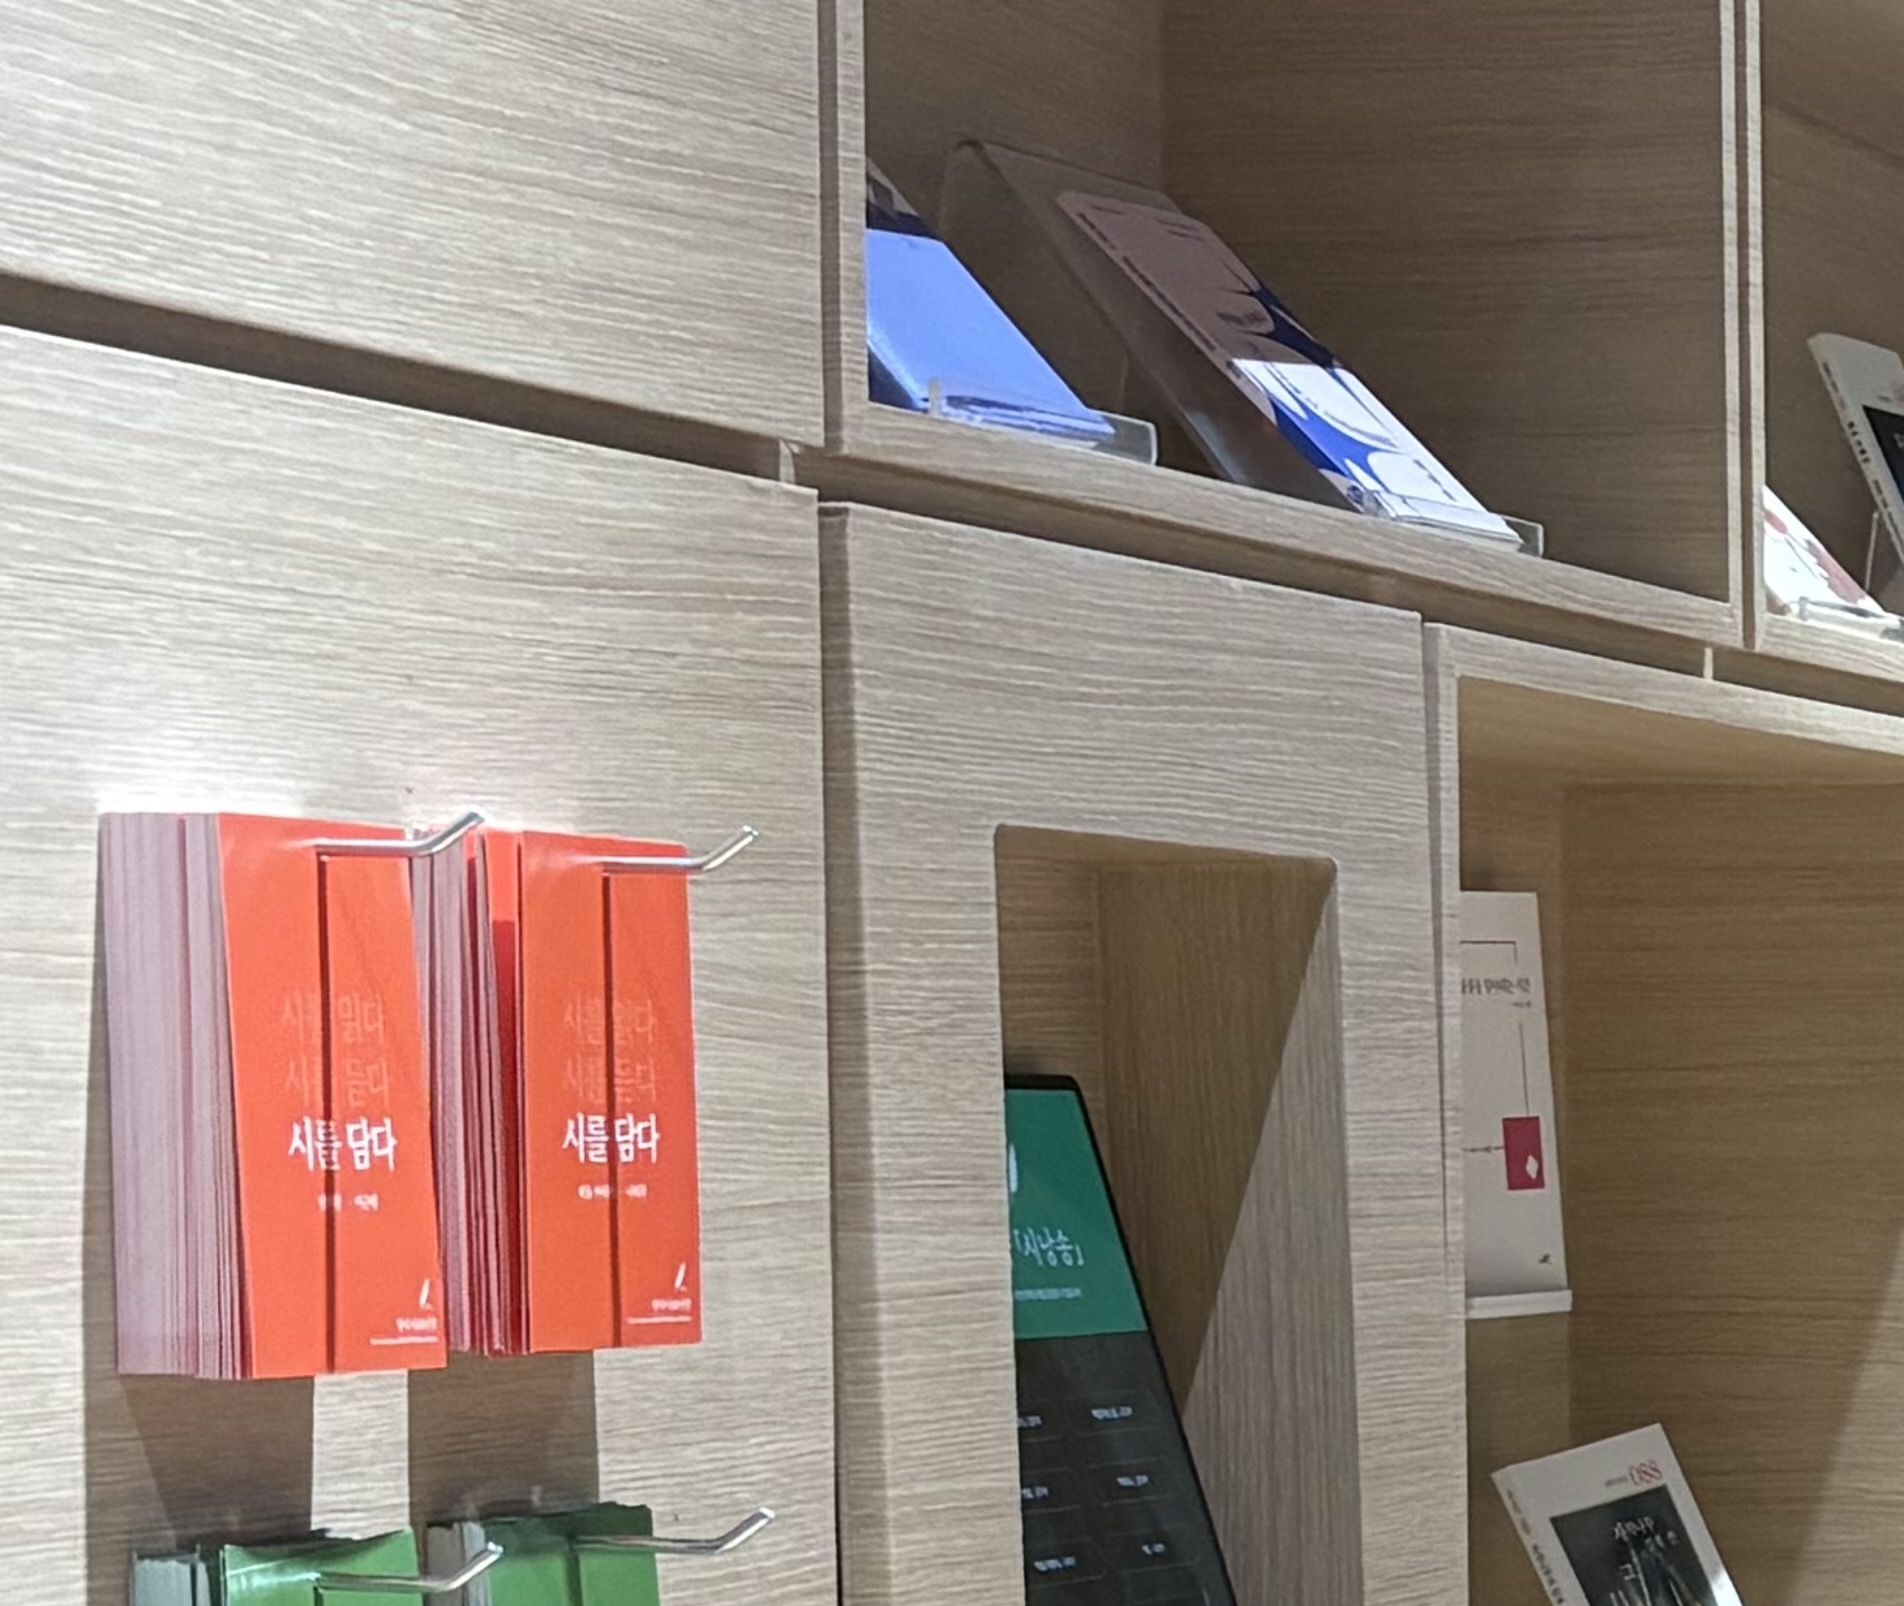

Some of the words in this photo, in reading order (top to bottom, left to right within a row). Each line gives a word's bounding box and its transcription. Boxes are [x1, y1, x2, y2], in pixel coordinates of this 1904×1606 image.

[288, 1115, 342, 1172] 시를
[345, 1116, 398, 1172] 담다
[562, 1112, 610, 1163] 시를
[614, 1112, 660, 1164] 담다
